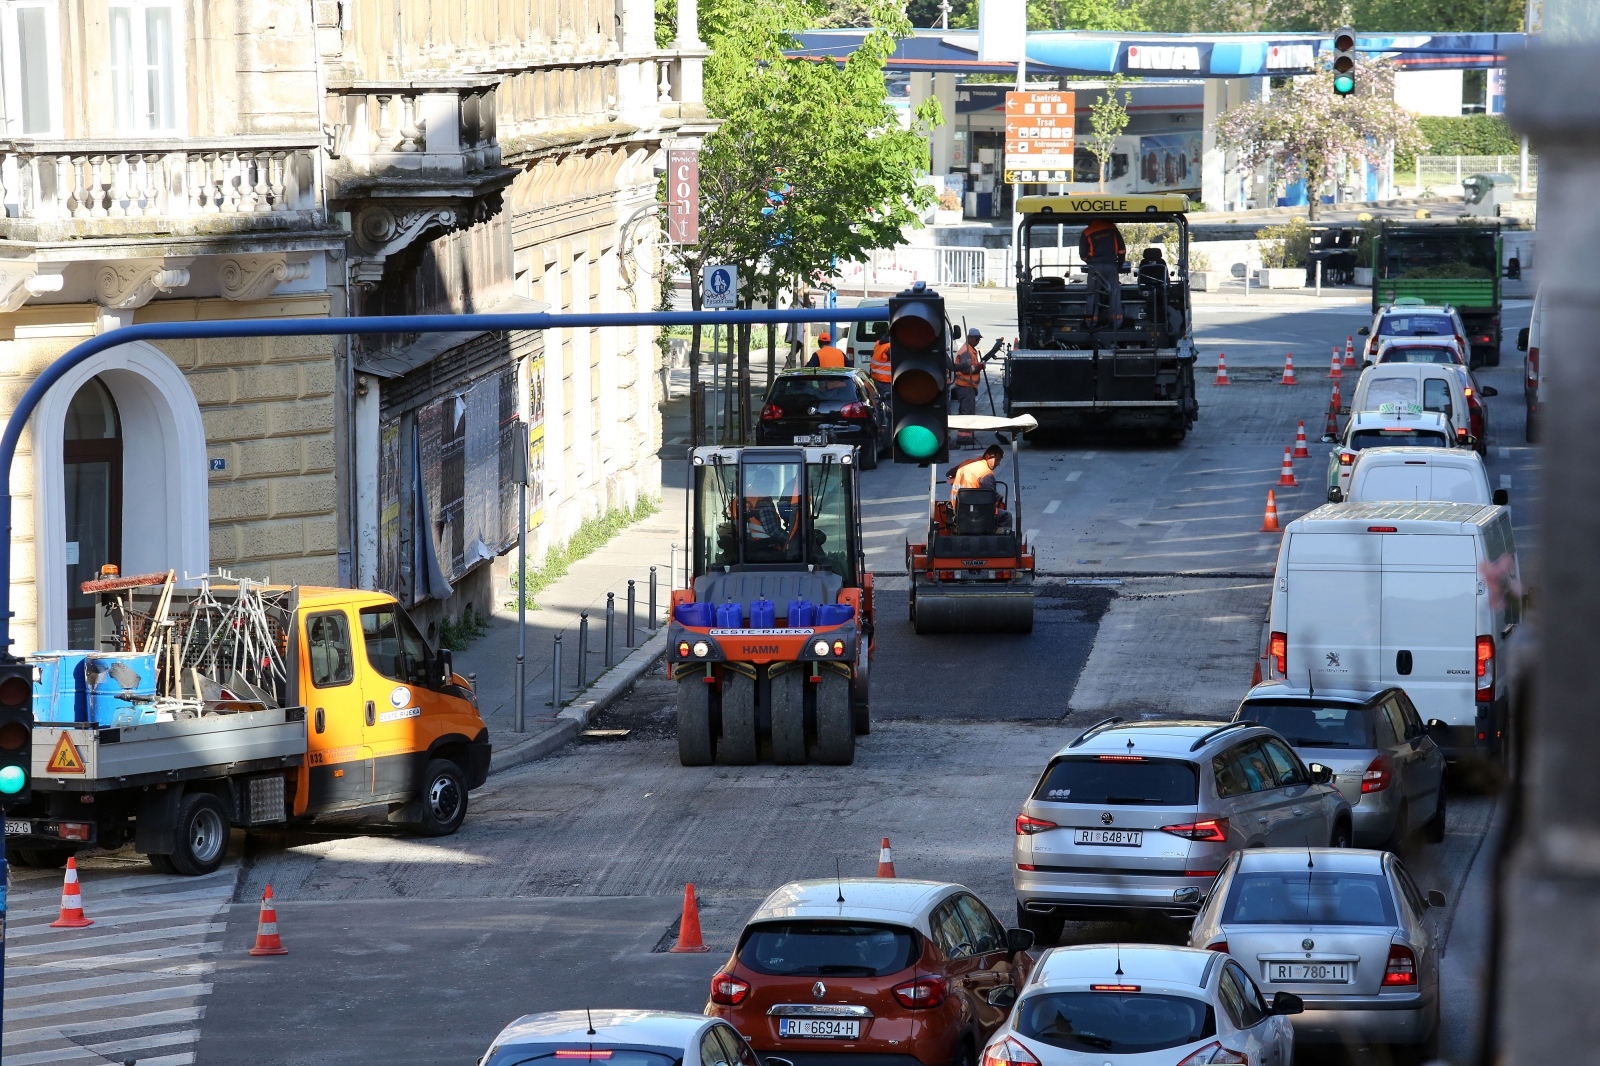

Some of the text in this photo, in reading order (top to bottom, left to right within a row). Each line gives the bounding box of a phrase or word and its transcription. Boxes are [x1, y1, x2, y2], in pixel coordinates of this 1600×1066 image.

[1031, 94, 1061, 103] Kantrida
[1036, 118, 1056, 126] Trsat
[1071, 199, 1128, 212] VÖGELE
[743, 645, 779, 654] HAMM
[309, 753, 323, 764] 832
[1081, 831, 1140, 843] RI 648-VT
[1278, 966, 1344, 979] RI 780-II
[788, 1021, 854, 1034] RI 6694-H
